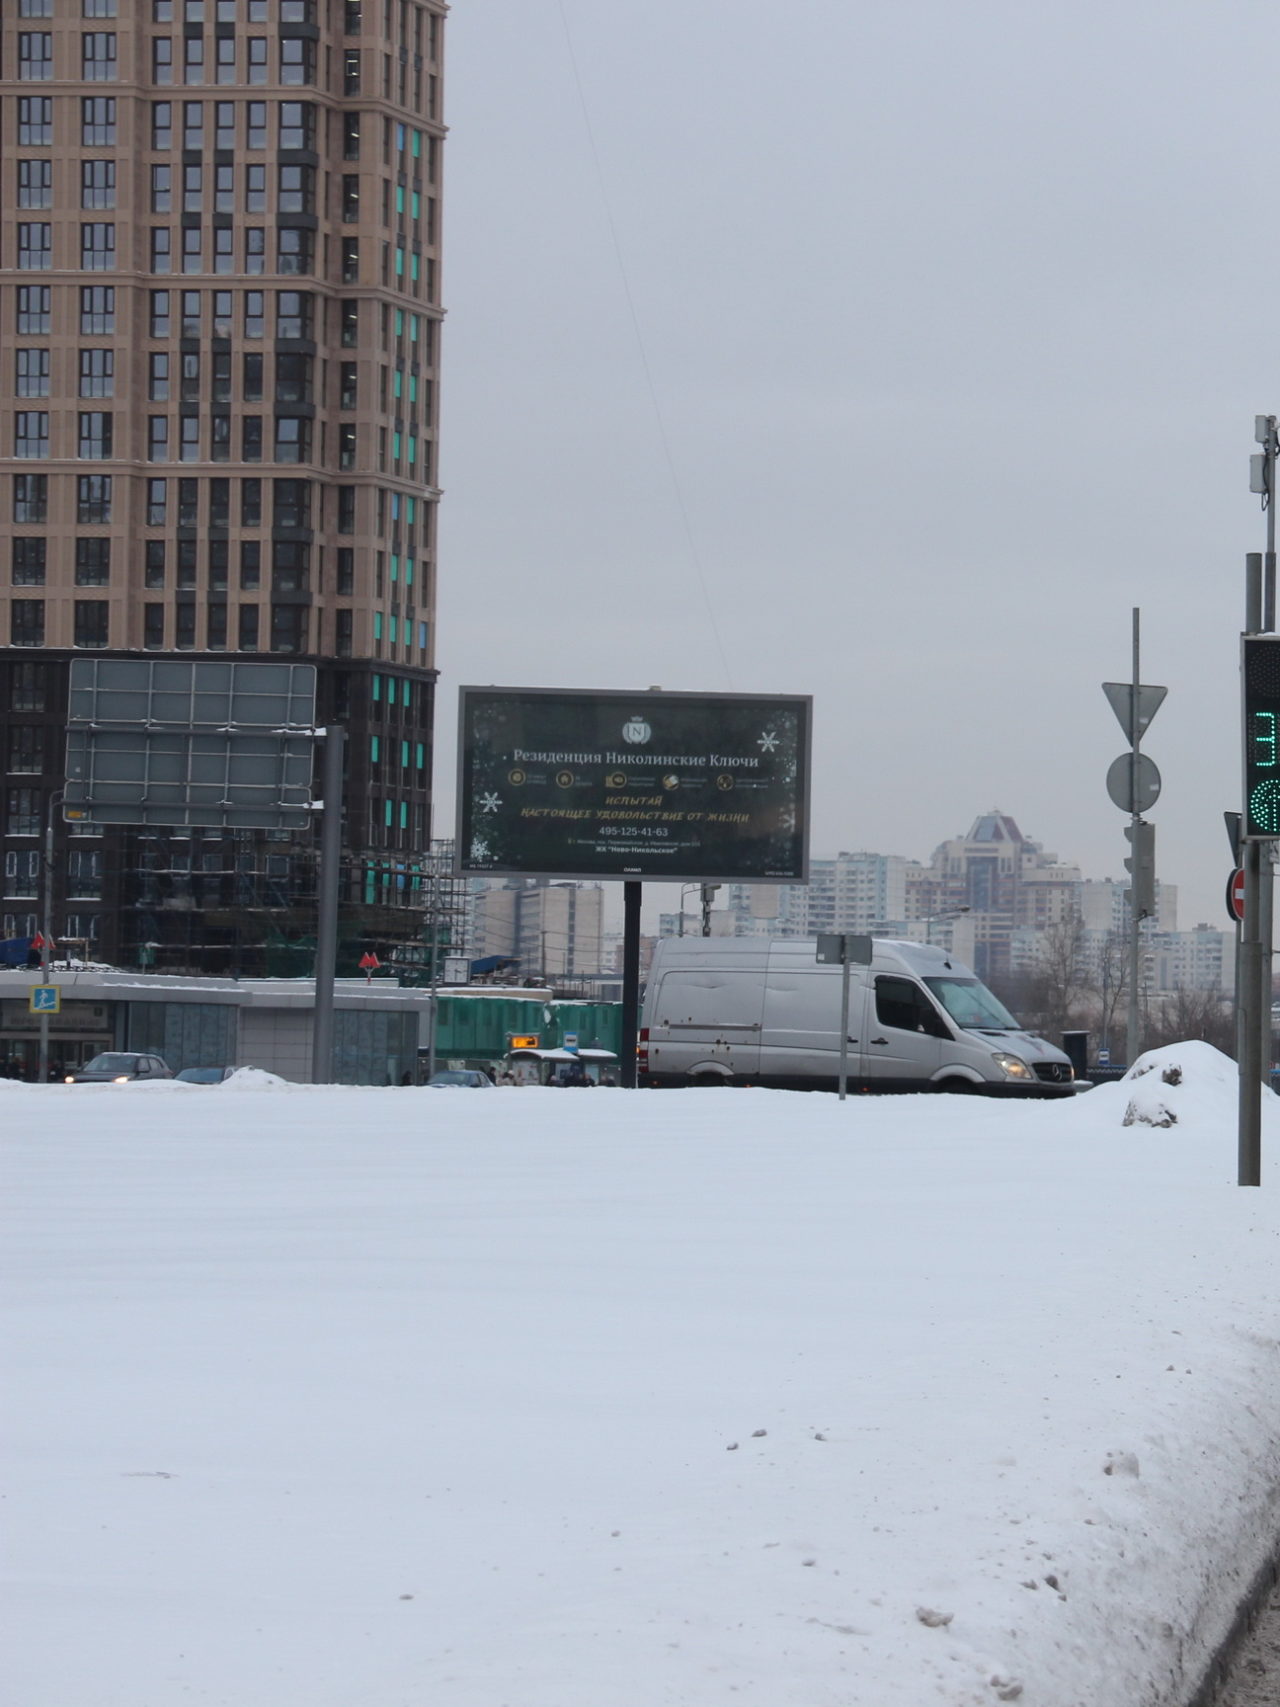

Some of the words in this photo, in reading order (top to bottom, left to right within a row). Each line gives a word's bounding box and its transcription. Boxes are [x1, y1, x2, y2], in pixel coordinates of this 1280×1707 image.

[513, 749, 602, 765] Резиденция
[606, 752, 706, 767] Николинские
[710, 754, 759, 767] Ключи
[520, 808, 592, 819] НАСТОЯЩЕЕ
[595, 810, 685, 821] УДОВОЛЬСТВИЕ
[687, 812, 705, 821] ОТ
[598, 826, 669, 837] 495-125-41-63
